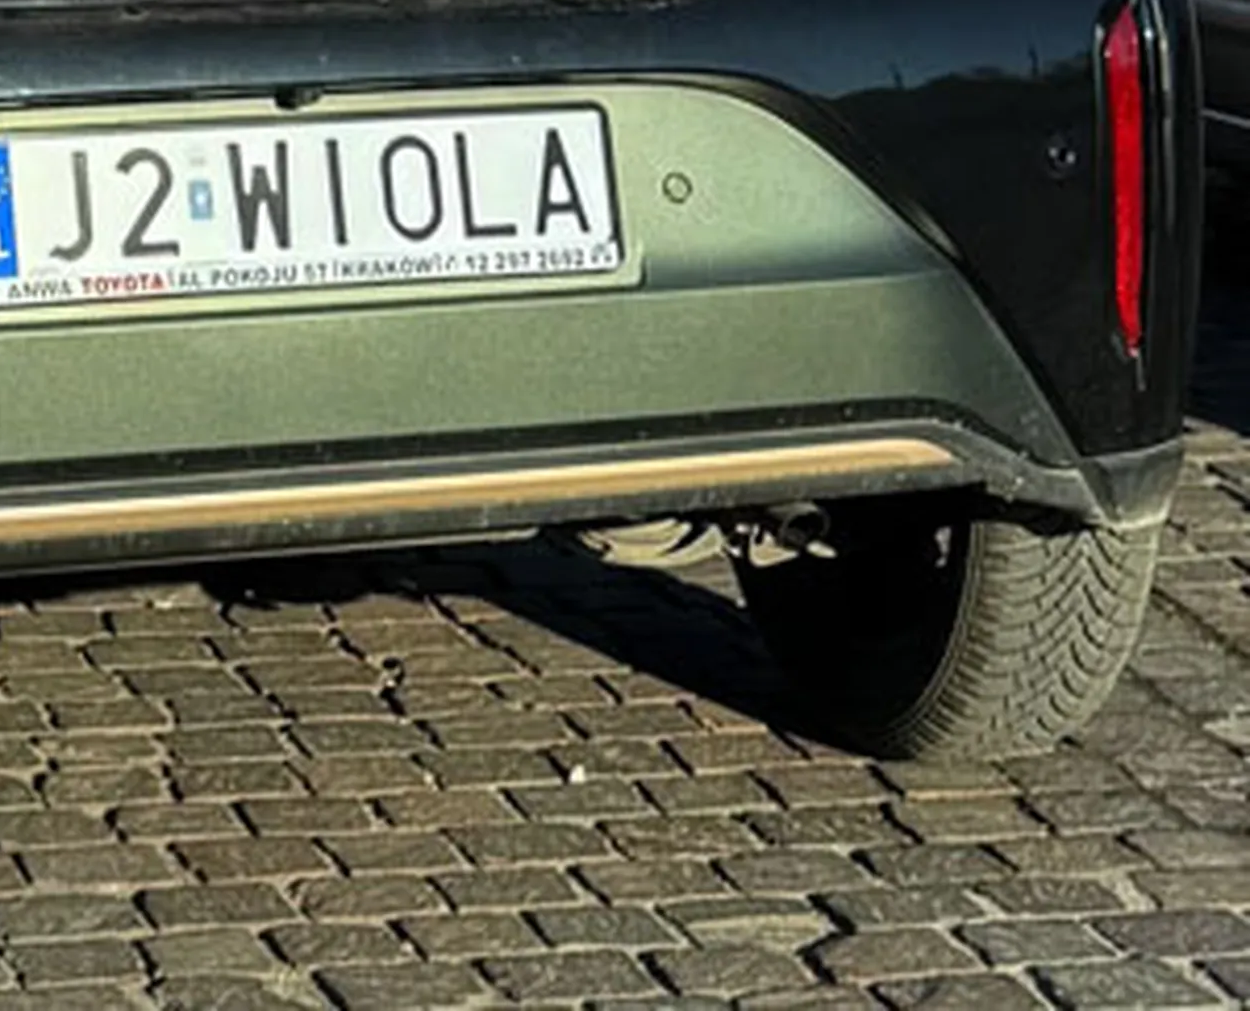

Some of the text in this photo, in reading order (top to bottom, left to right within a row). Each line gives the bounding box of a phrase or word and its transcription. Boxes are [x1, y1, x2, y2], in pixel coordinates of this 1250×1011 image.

[49, 127, 591, 262] J2 WIOLA
[80, 271, 164, 295] TOYOTA
